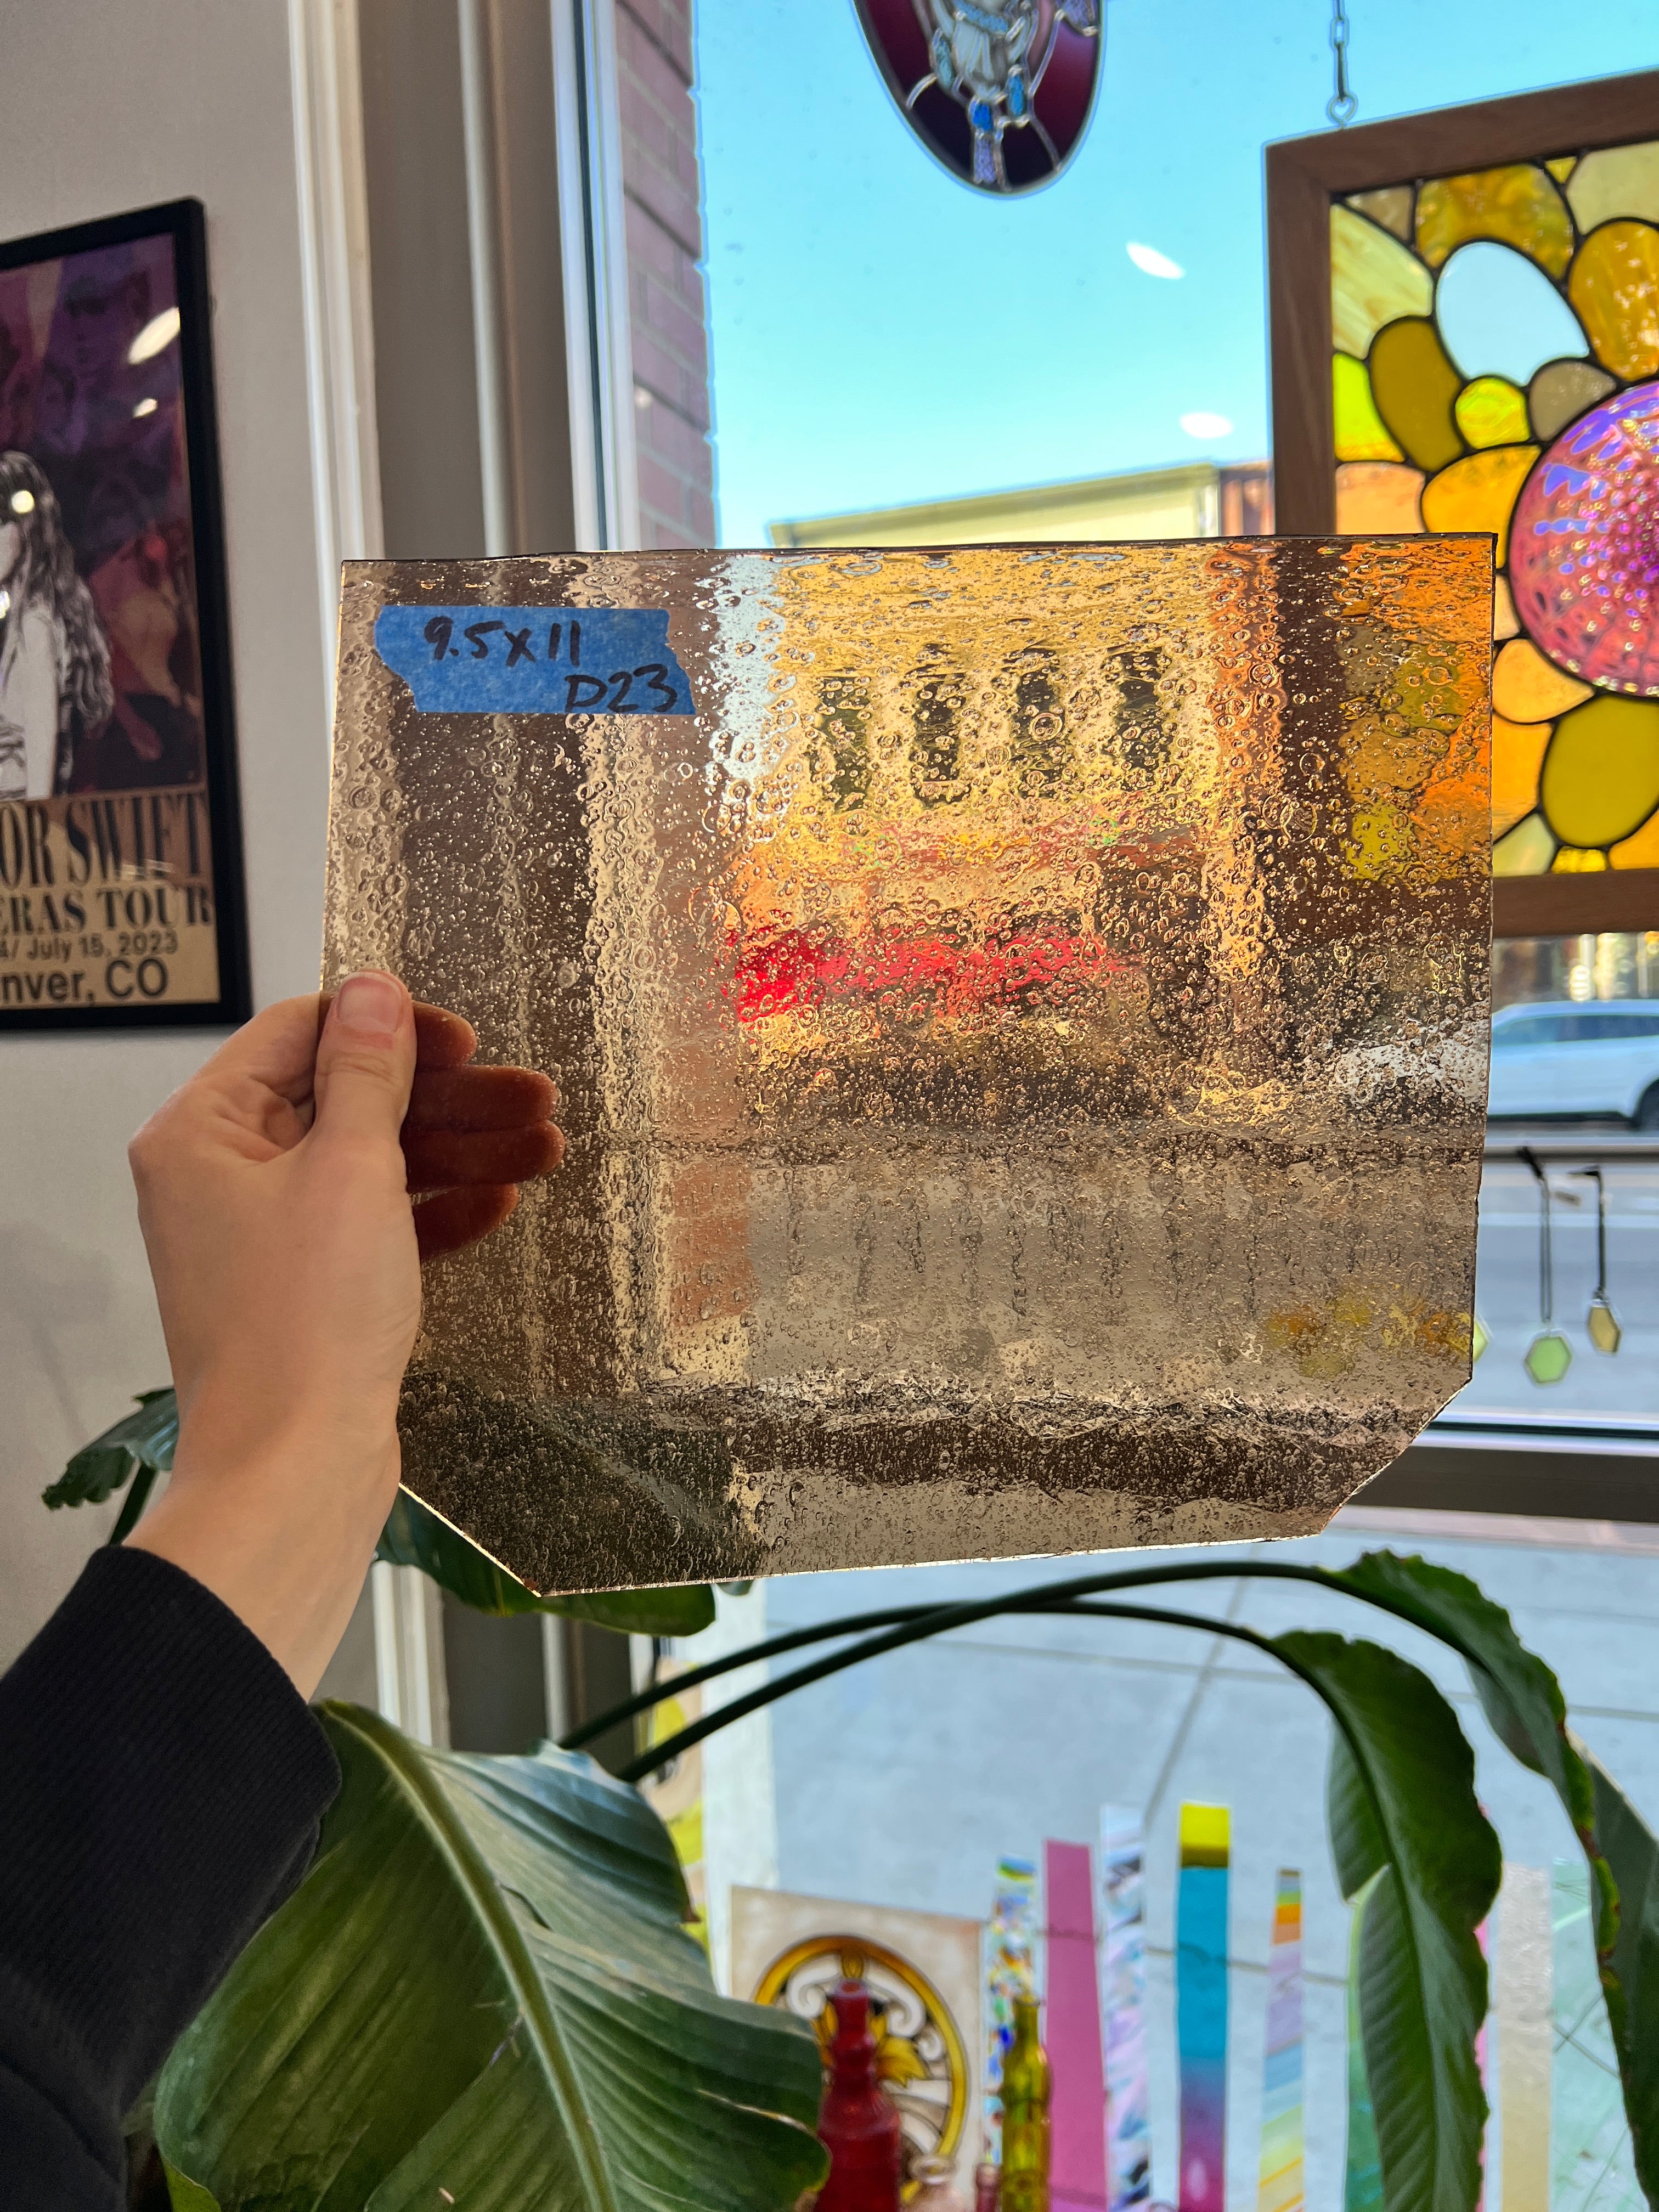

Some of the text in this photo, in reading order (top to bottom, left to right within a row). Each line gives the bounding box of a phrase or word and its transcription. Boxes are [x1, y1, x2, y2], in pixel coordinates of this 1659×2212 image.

[564, 663, 678, 713] D23
[65, 791, 209, 885] SWIFT
[97, 885, 213, 930] TOUR
[29, 936, 71, 962] July
[119, 929, 178, 956] 2023
[106, 958, 168, 998] CO
